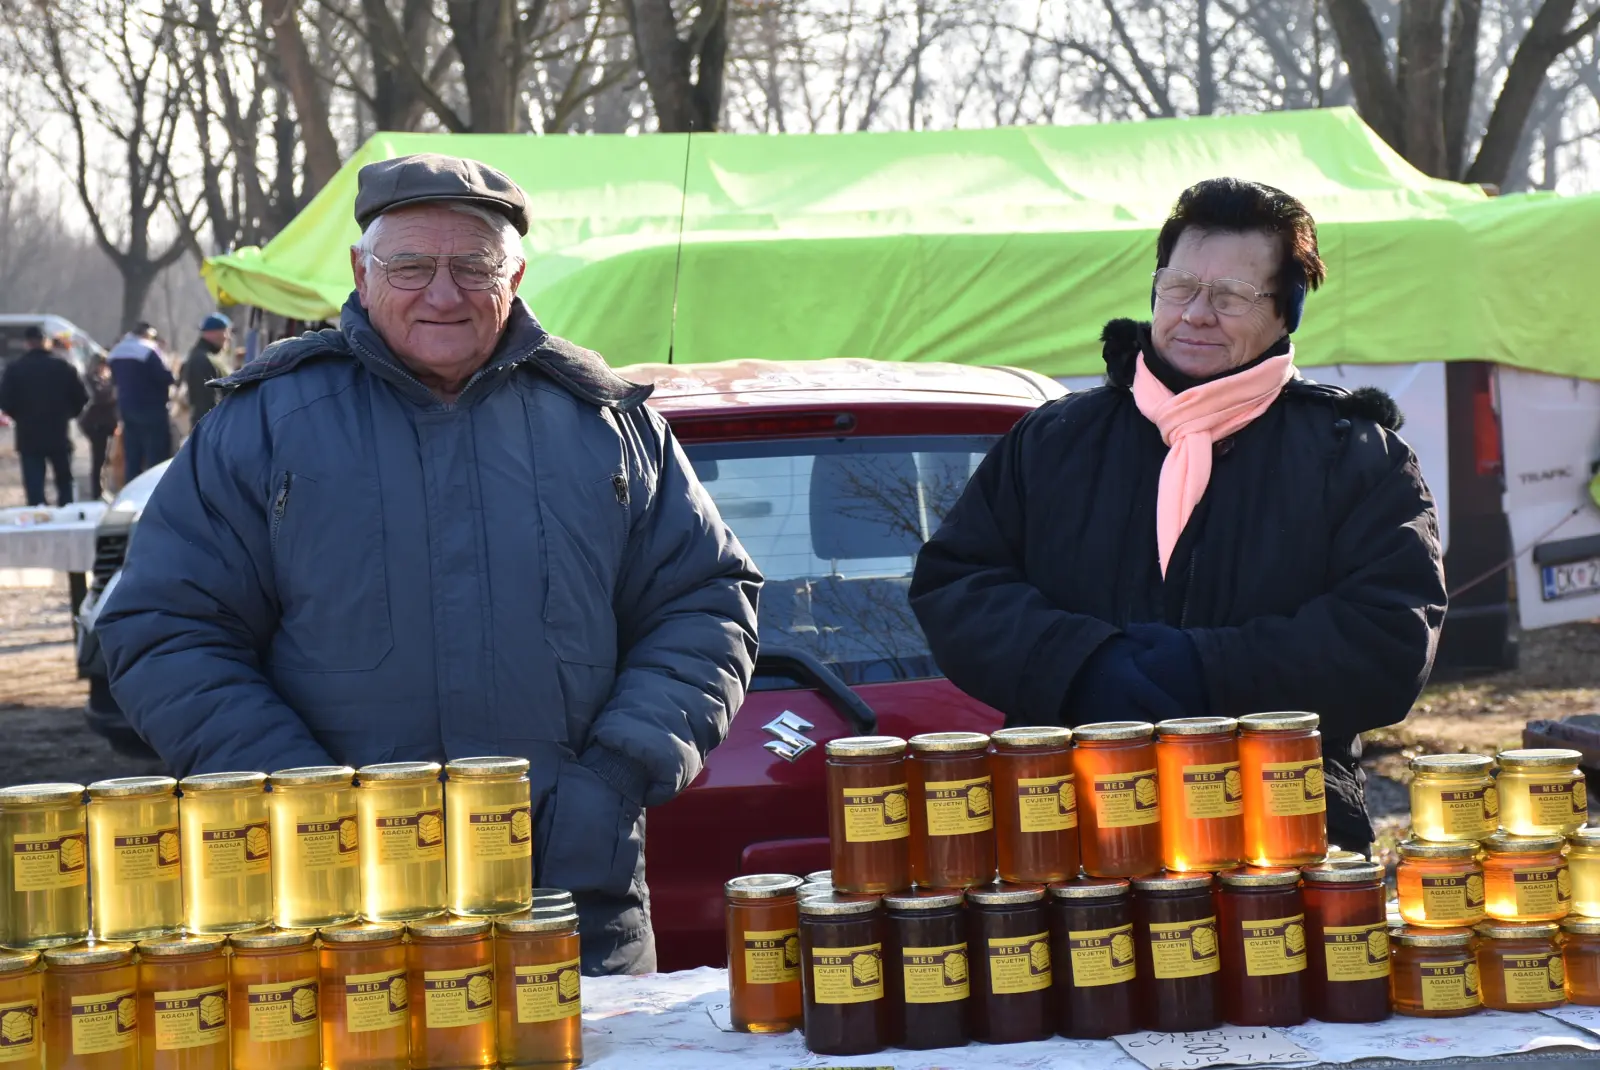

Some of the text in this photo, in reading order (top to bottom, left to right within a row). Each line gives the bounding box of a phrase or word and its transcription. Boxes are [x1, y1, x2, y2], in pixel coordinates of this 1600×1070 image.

[1194, 773, 1216, 781] MED
[1274, 771, 1295, 780] MED
[1029, 786, 1050, 794] MED
[1104, 782, 1125, 790] MED
[1542, 784, 1564, 792] MED
[936, 790, 957, 798] MED
[1453, 792, 1476, 800] MED
[853, 796, 874, 804] MED
[386, 818, 408, 826] MED
[480, 814, 502, 822] MED
[308, 823, 330, 831] MED
[475, 824, 507, 832] AGACIJA
[213, 831, 236, 839] MED
[381, 828, 413, 836] AGACIJA
[126, 836, 149, 845] MED
[25, 843, 49, 851] MED
[208, 842, 242, 850] AGACIJA
[121, 847, 155, 855] AGACIJA
[1527, 872, 1549, 880] MED
[1434, 878, 1457, 886] MED
[1523, 883, 1554, 891] AGACIJA
[1159, 931, 1181, 939] MED
[1253, 929, 1275, 937] MED
[1336, 934, 1358, 942] MED
[754, 940, 775, 948] MED
[1079, 939, 1101, 947] MED
[1157, 942, 1187, 950] CVJETNI
[999, 947, 1020, 955] MED
[1076, 950, 1106, 958] CVJETNI
[821, 956, 843, 965] MED
[913, 956, 934, 964] MED
[996, 957, 1026, 965] CVJETNI
[1434, 967, 1456, 975] MED
[1513, 970, 1544, 978] AGACIJA
[526, 974, 548, 983] MED
[357, 983, 380, 992] MED
[435, 980, 457, 989] MED
[522, 985, 554, 993] AGACIJA
[259, 993, 282, 1002] MED
[353, 994, 385, 1002] AGACIJA
[84, 1003, 107, 1012] MED
[165, 1000, 188, 1009] MED
[254, 1004, 287, 1012] AGACIJA
[78, 1015, 113, 1023] AGACIJA
[161, 1011, 194, 1020] AGACIJA
[1268, 1052, 1308, 1060] KG
